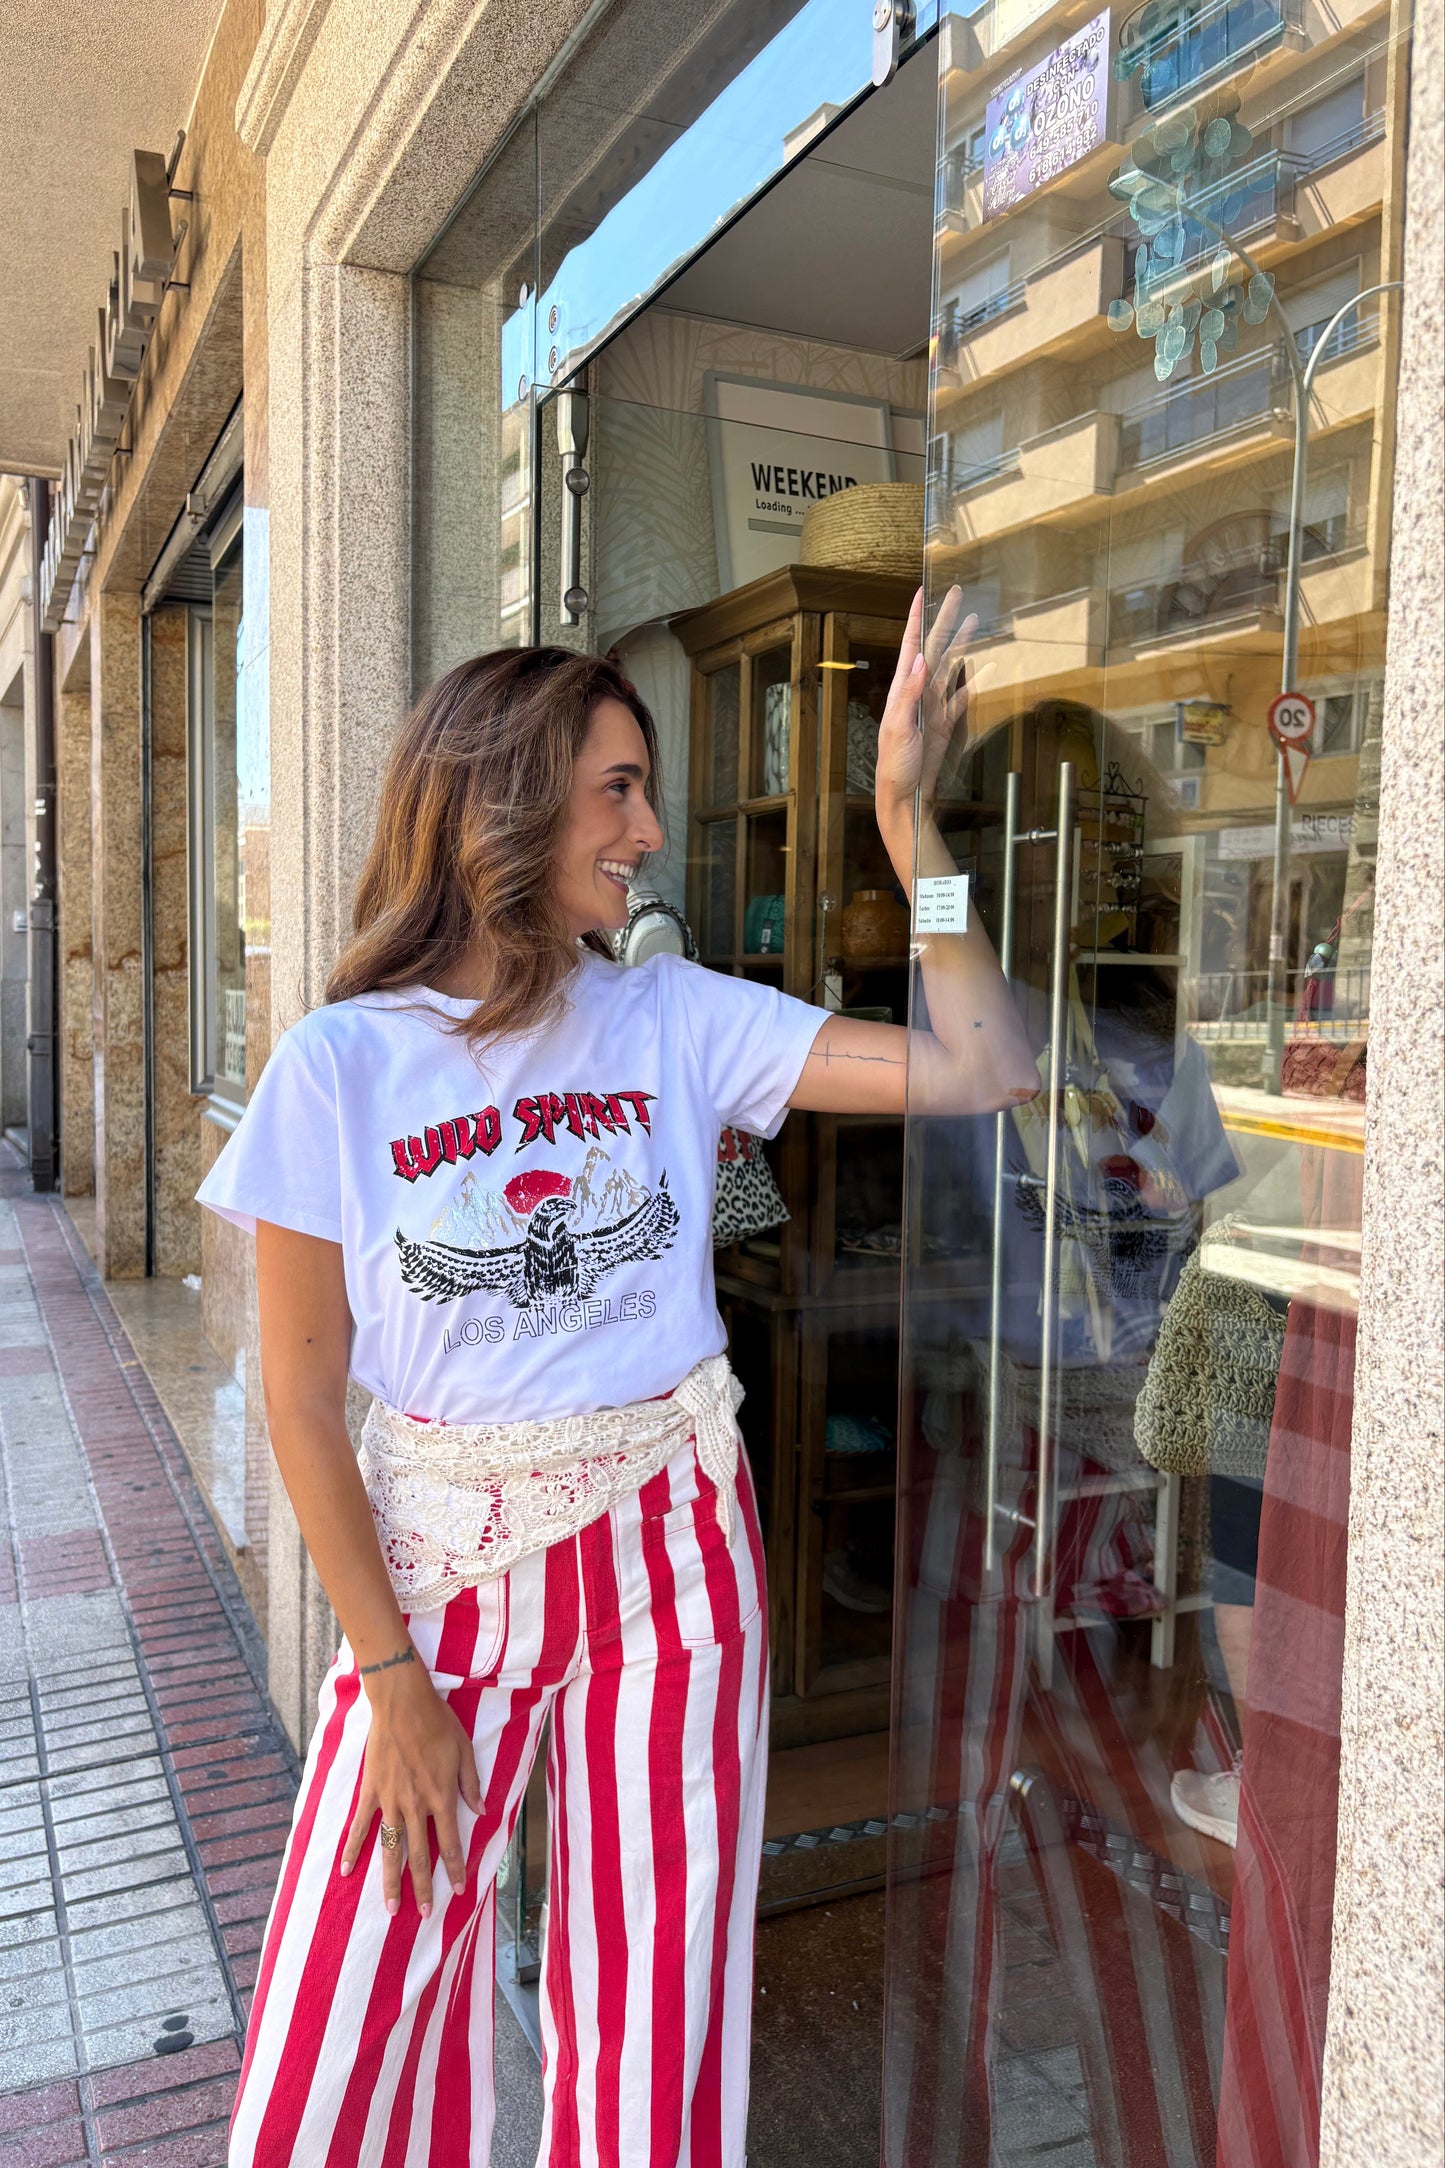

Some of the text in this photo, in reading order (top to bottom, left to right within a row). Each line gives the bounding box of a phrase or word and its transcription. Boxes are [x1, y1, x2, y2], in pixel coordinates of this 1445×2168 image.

[1025, 27, 1105, 96] DESINFECTADO
[1053, 67, 1076, 93] CON
[1030, 100, 1099, 160] 649 585 710
[1033, 74, 1095, 137] OZONO
[1028, 159, 1049, 183] 618
[1076, 125, 1098, 148] 932
[755, 498, 792, 516] Loading
[389, 1105, 503, 1184] WILD
[512, 1091, 658, 1155] SPIRIT
[443, 1290, 657, 1354] LOS ANGELES
